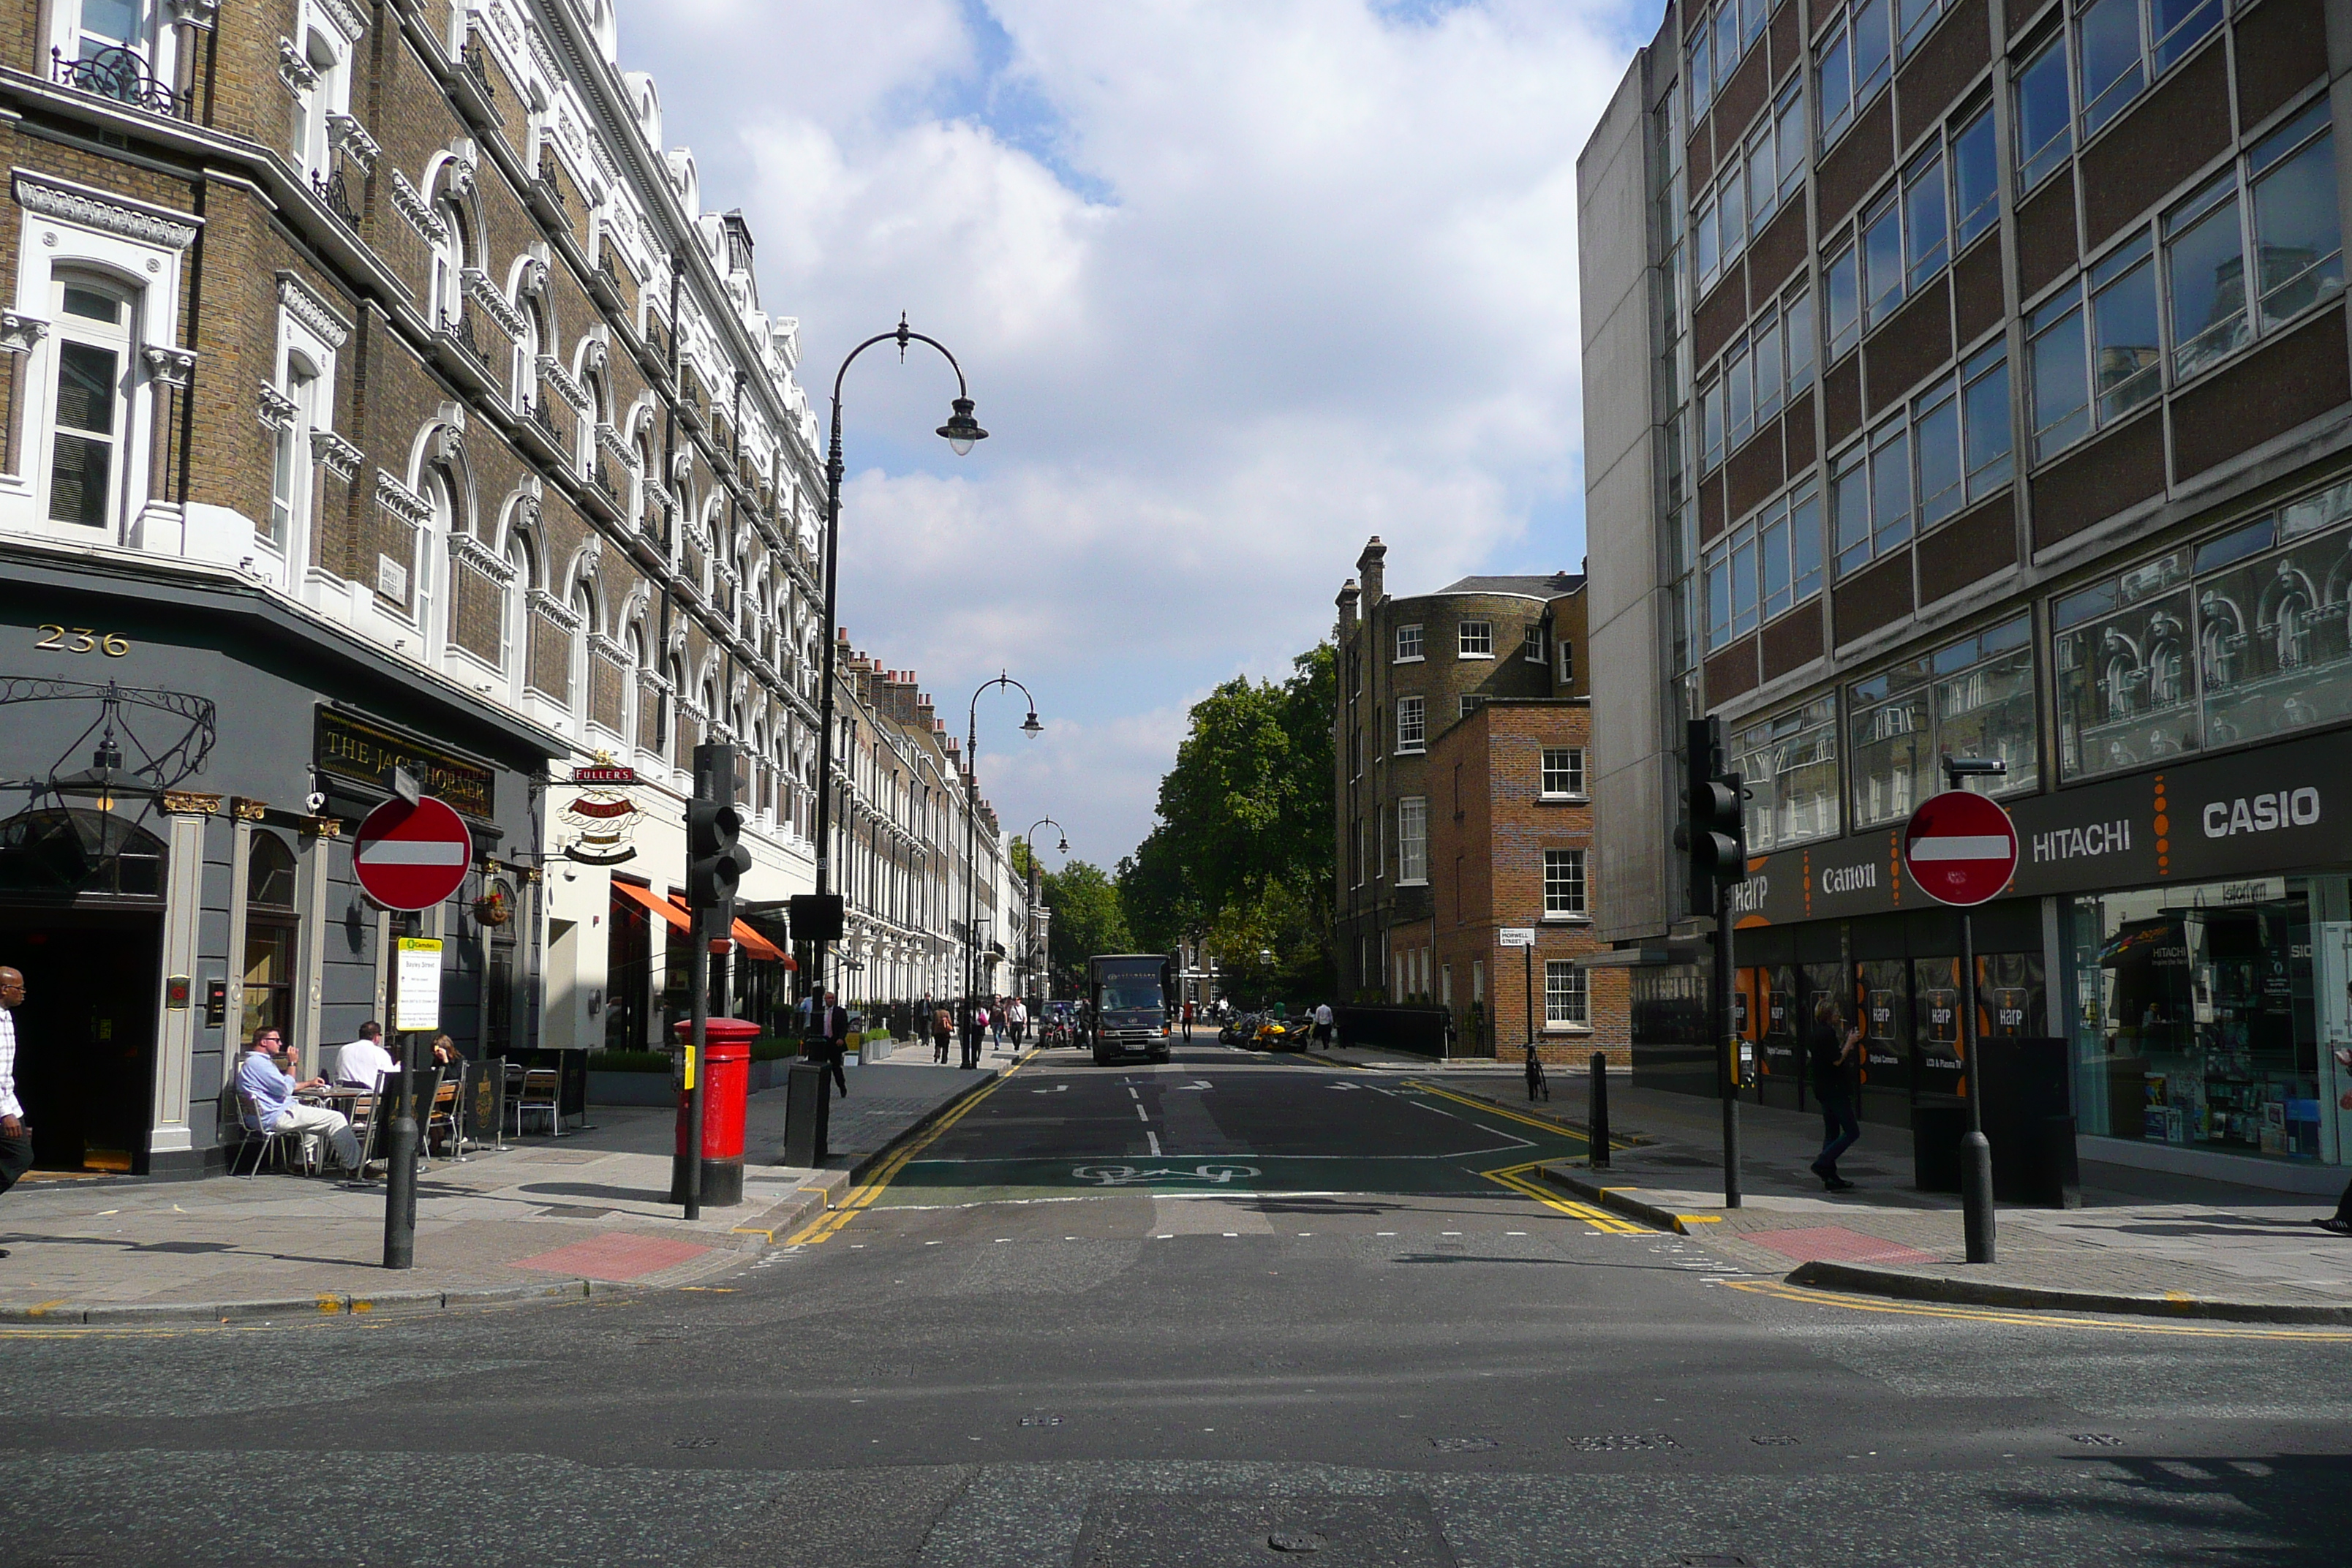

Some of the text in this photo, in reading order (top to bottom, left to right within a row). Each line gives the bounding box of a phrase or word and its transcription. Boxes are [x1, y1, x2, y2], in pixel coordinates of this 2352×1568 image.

[382, 578, 397, 596] STREET
[35, 624, 129, 656] 236
[328, 731, 484, 802] THE JAC HORNER
[574, 800, 599, 816] ALE
[609, 801, 632, 815] PIE
[2203, 786, 2321, 839] CASIO
[585, 834, 619, 845] HOUSE
[2032, 818, 2131, 863] HITACHI
[1823, 862, 1877, 894] Canon
[2152, 946, 2187, 958] HITACHI
[406, 960, 421, 970] Bayley
[1869, 1054, 1899, 1065] Digital Cameras
[1926, 1058, 1934, 1067] LCD
[1940, 1059, 1956, 1068] Plasma
[1956, 1060, 1961, 1069] TV
